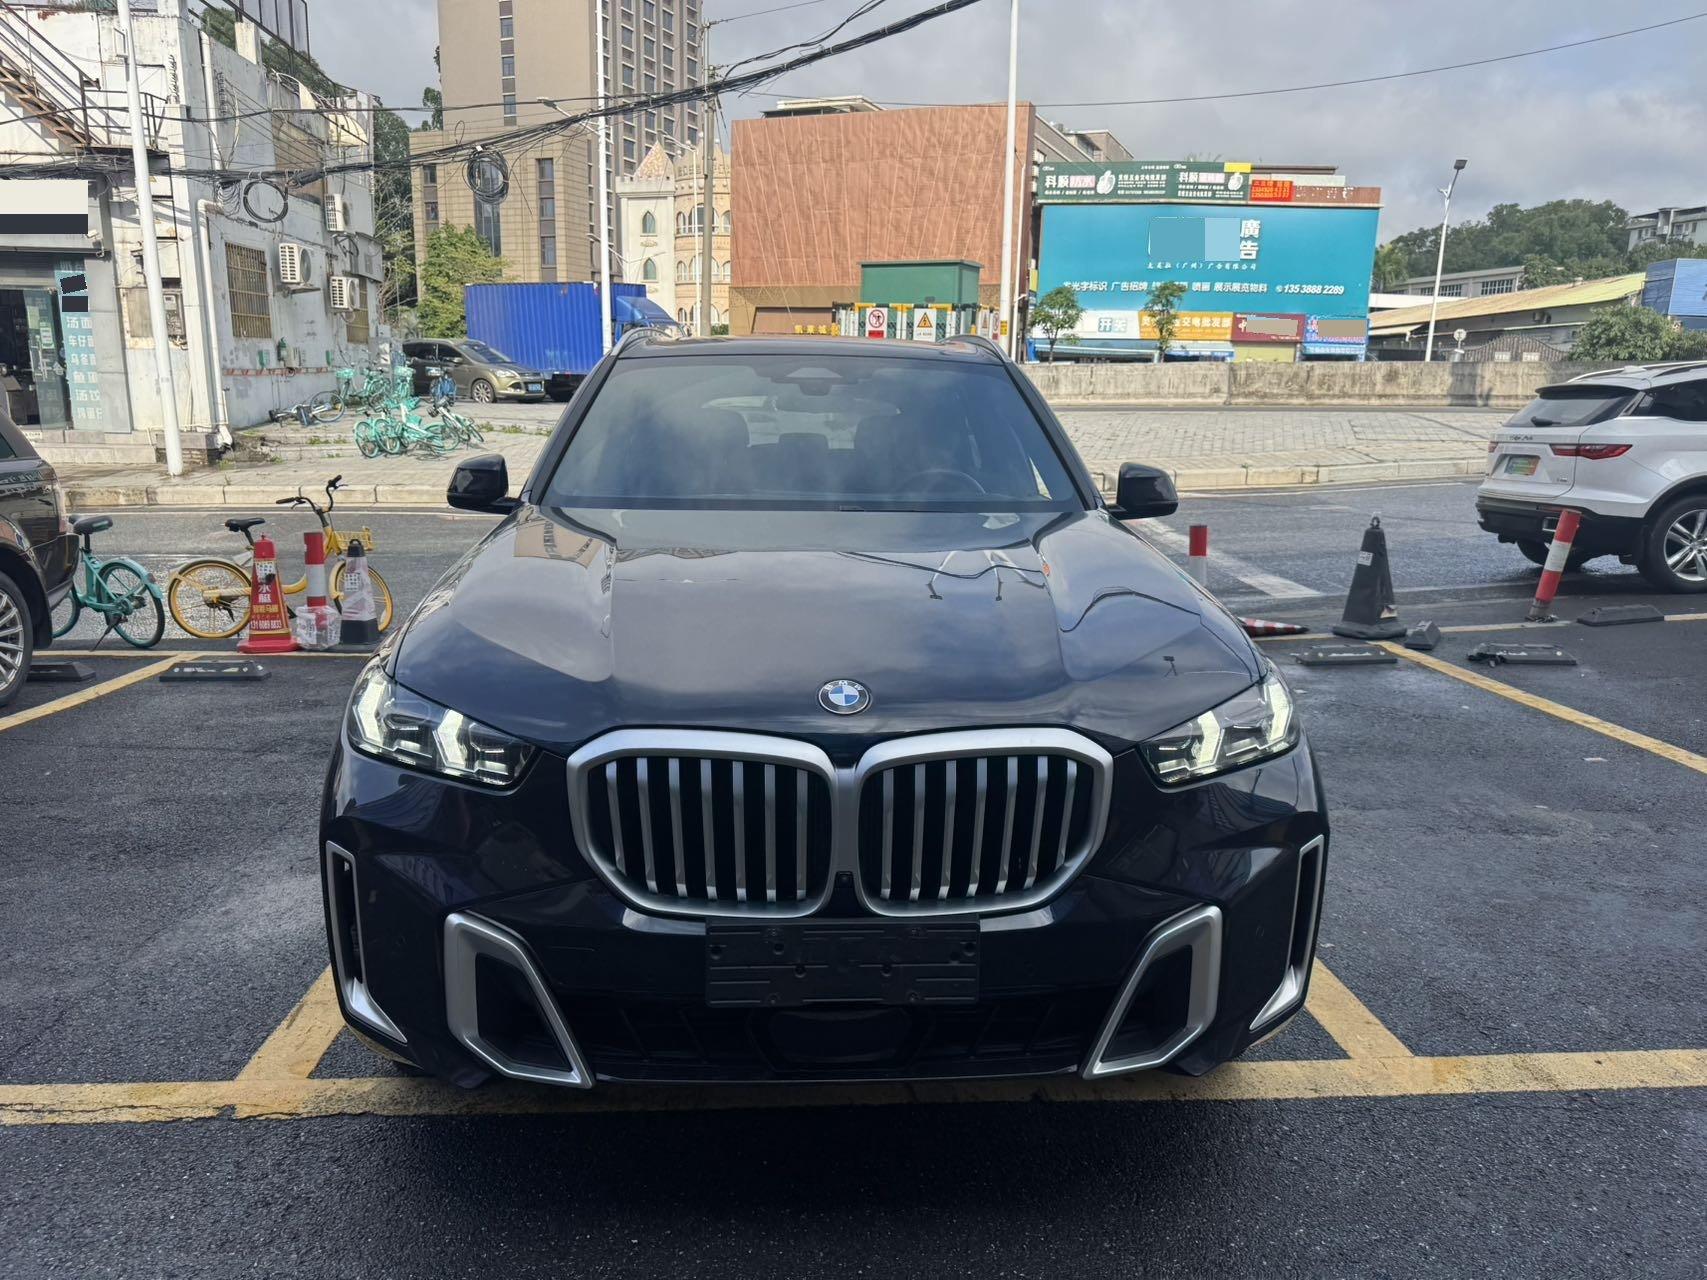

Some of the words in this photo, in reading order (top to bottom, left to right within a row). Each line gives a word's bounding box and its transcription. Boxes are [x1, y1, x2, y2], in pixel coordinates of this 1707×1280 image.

[1111, 281, 1149, 291] 广告招牌
[1284, 284, 1300, 293] 135
[824, 680, 864, 691] BMW
